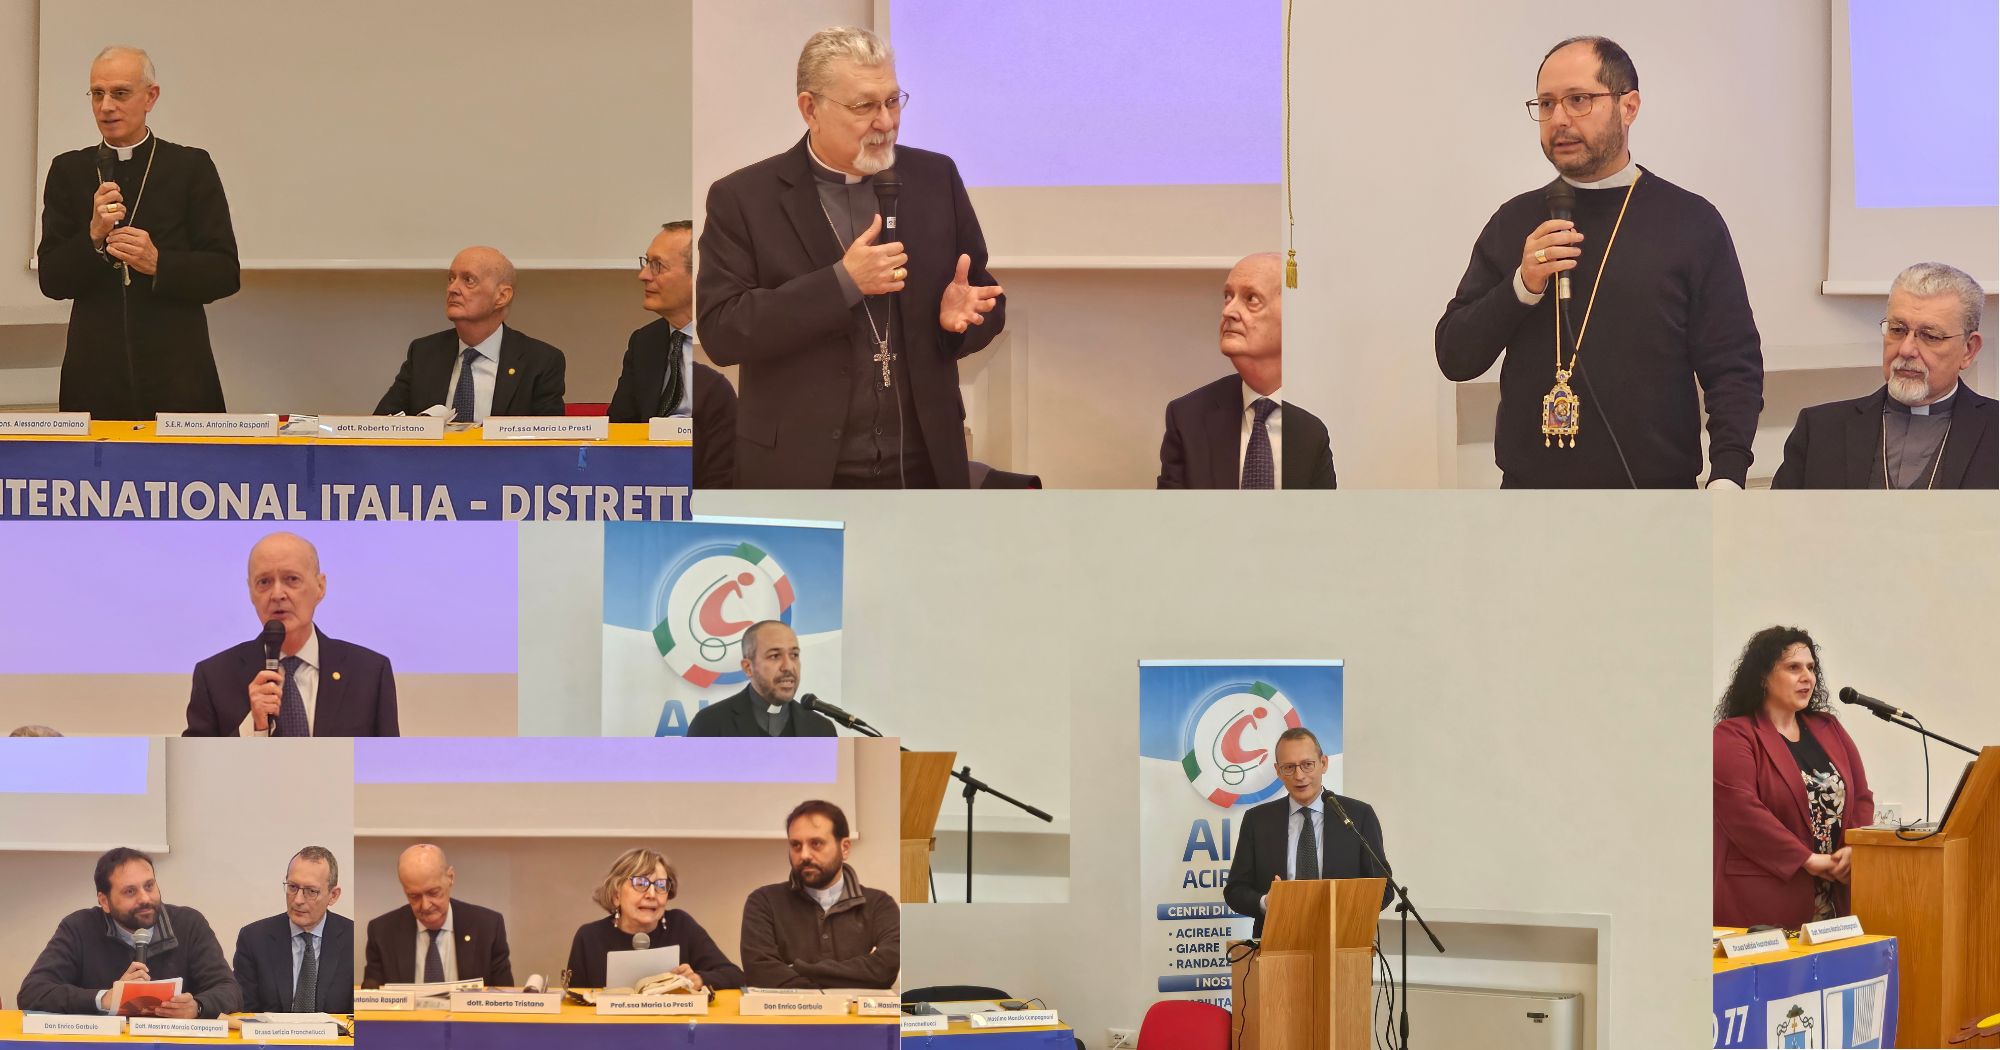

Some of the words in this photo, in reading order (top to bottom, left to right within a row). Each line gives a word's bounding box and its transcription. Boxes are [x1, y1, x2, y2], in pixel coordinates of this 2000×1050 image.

[14, 420, 51, 428] Alessandro
[53, 420, 85, 428] Damiano
[206, 421, 238, 429] Antonino
[239, 421, 270, 429] Raspanti
[337, 424, 356, 432] dott.
[358, 424, 390, 432] Roberto
[0, 479, 307, 520] TERNATIONAL
[321, 484, 457, 520] ITALIA
[502, 485, 693, 520] DISTRETT
[1168, 906, 1210, 917] CENTRI
[1212, 905, 1224, 915] DI
[1176, 927, 1232, 938] ACIREALE
[1176, 943, 1220, 953] GIARRE
[1196, 978, 1200, 988] I
[1724, 1005, 1749, 1046] 77
